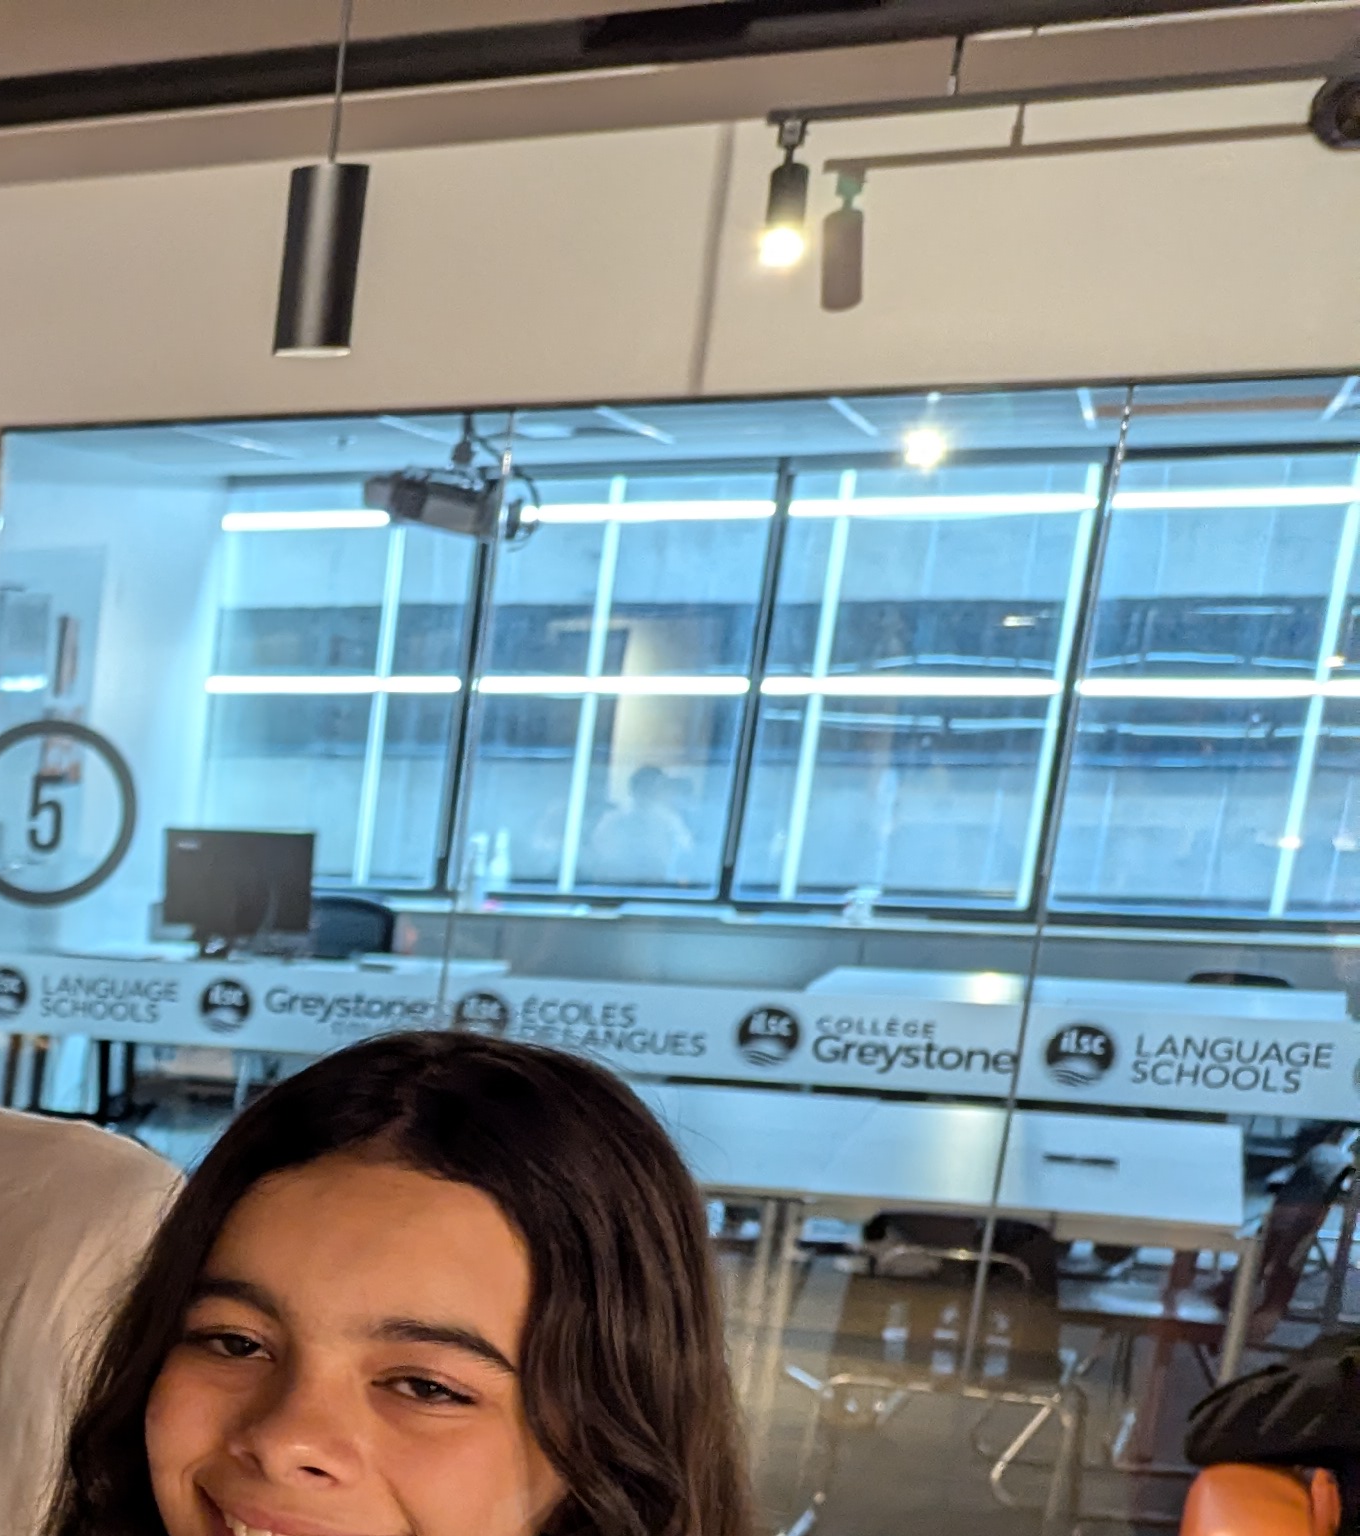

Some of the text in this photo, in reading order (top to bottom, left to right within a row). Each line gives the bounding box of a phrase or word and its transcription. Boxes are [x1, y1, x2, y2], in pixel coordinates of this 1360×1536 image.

[28, 773, 63, 853] 5
[41, 974, 179, 1002] LANGUAGE
[264, 987, 431, 1023] Greystone
[40, 998, 160, 1024] SCHOOLS
[812, 1035, 1018, 1075] Greystone
[1134, 1033, 1335, 1070] LANGUAGE
[1131, 1059, 1303, 1094] SCHOOLS
